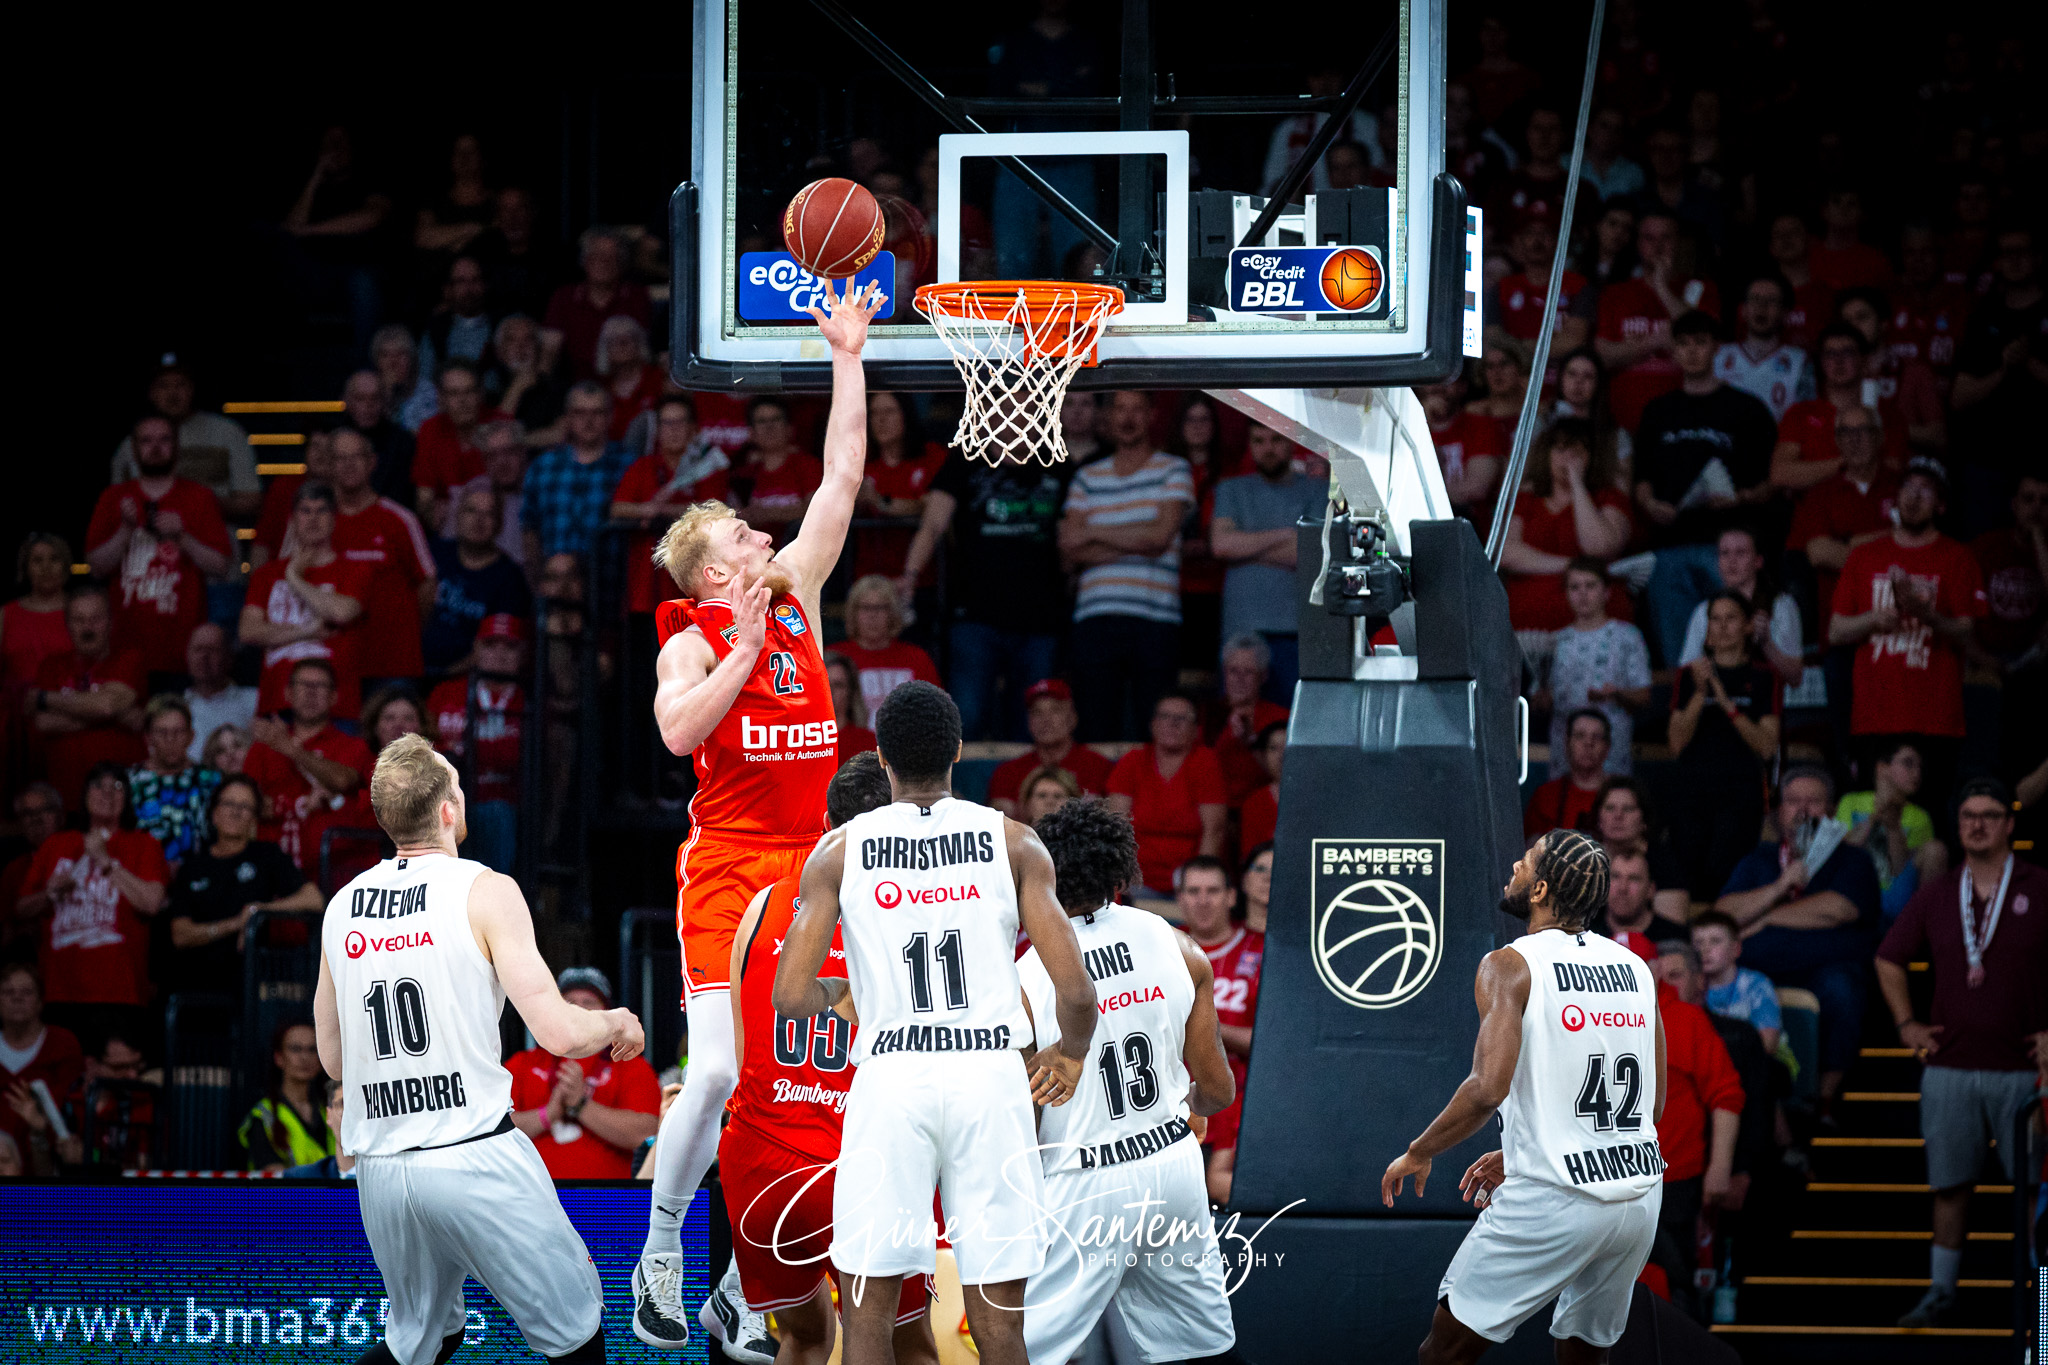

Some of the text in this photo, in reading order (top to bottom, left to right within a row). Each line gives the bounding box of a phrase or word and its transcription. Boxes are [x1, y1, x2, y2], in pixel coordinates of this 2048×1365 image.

[1260, 266, 1305, 279] Credit
[1241, 282, 1304, 307] BBL
[769, 652, 804, 695] 22
[742, 716, 838, 749] brose
[743, 753, 783, 762] Technik
[785, 752, 795, 761] für
[862, 831, 994, 871] CHRISTMAS
[1322, 848, 1433, 863] BAMBERG
[1322, 864, 1433, 875] BASKETS
[351, 883, 428, 919] DZIEWA
[907, 884, 980, 904] VEOLIA
[371, 931, 434, 952] VEOLIA
[903, 929, 969, 1013] 11
[1084, 942, 1134, 981] KING
[1553, 962, 1639, 992] DURHAM
[1098, 986, 1165, 1015] VEOLIA
[364, 977, 430, 1060] 10
[1590, 1012, 1646, 1028] VEOLIA
[871, 1024, 1011, 1056] HAMBURG
[1098, 1031, 1160, 1121] 13
[362, 1072, 467, 1119] HAMBURG
[773, 1079, 848, 1114] Bamberg
[1575, 1053, 1642, 1132] 42
